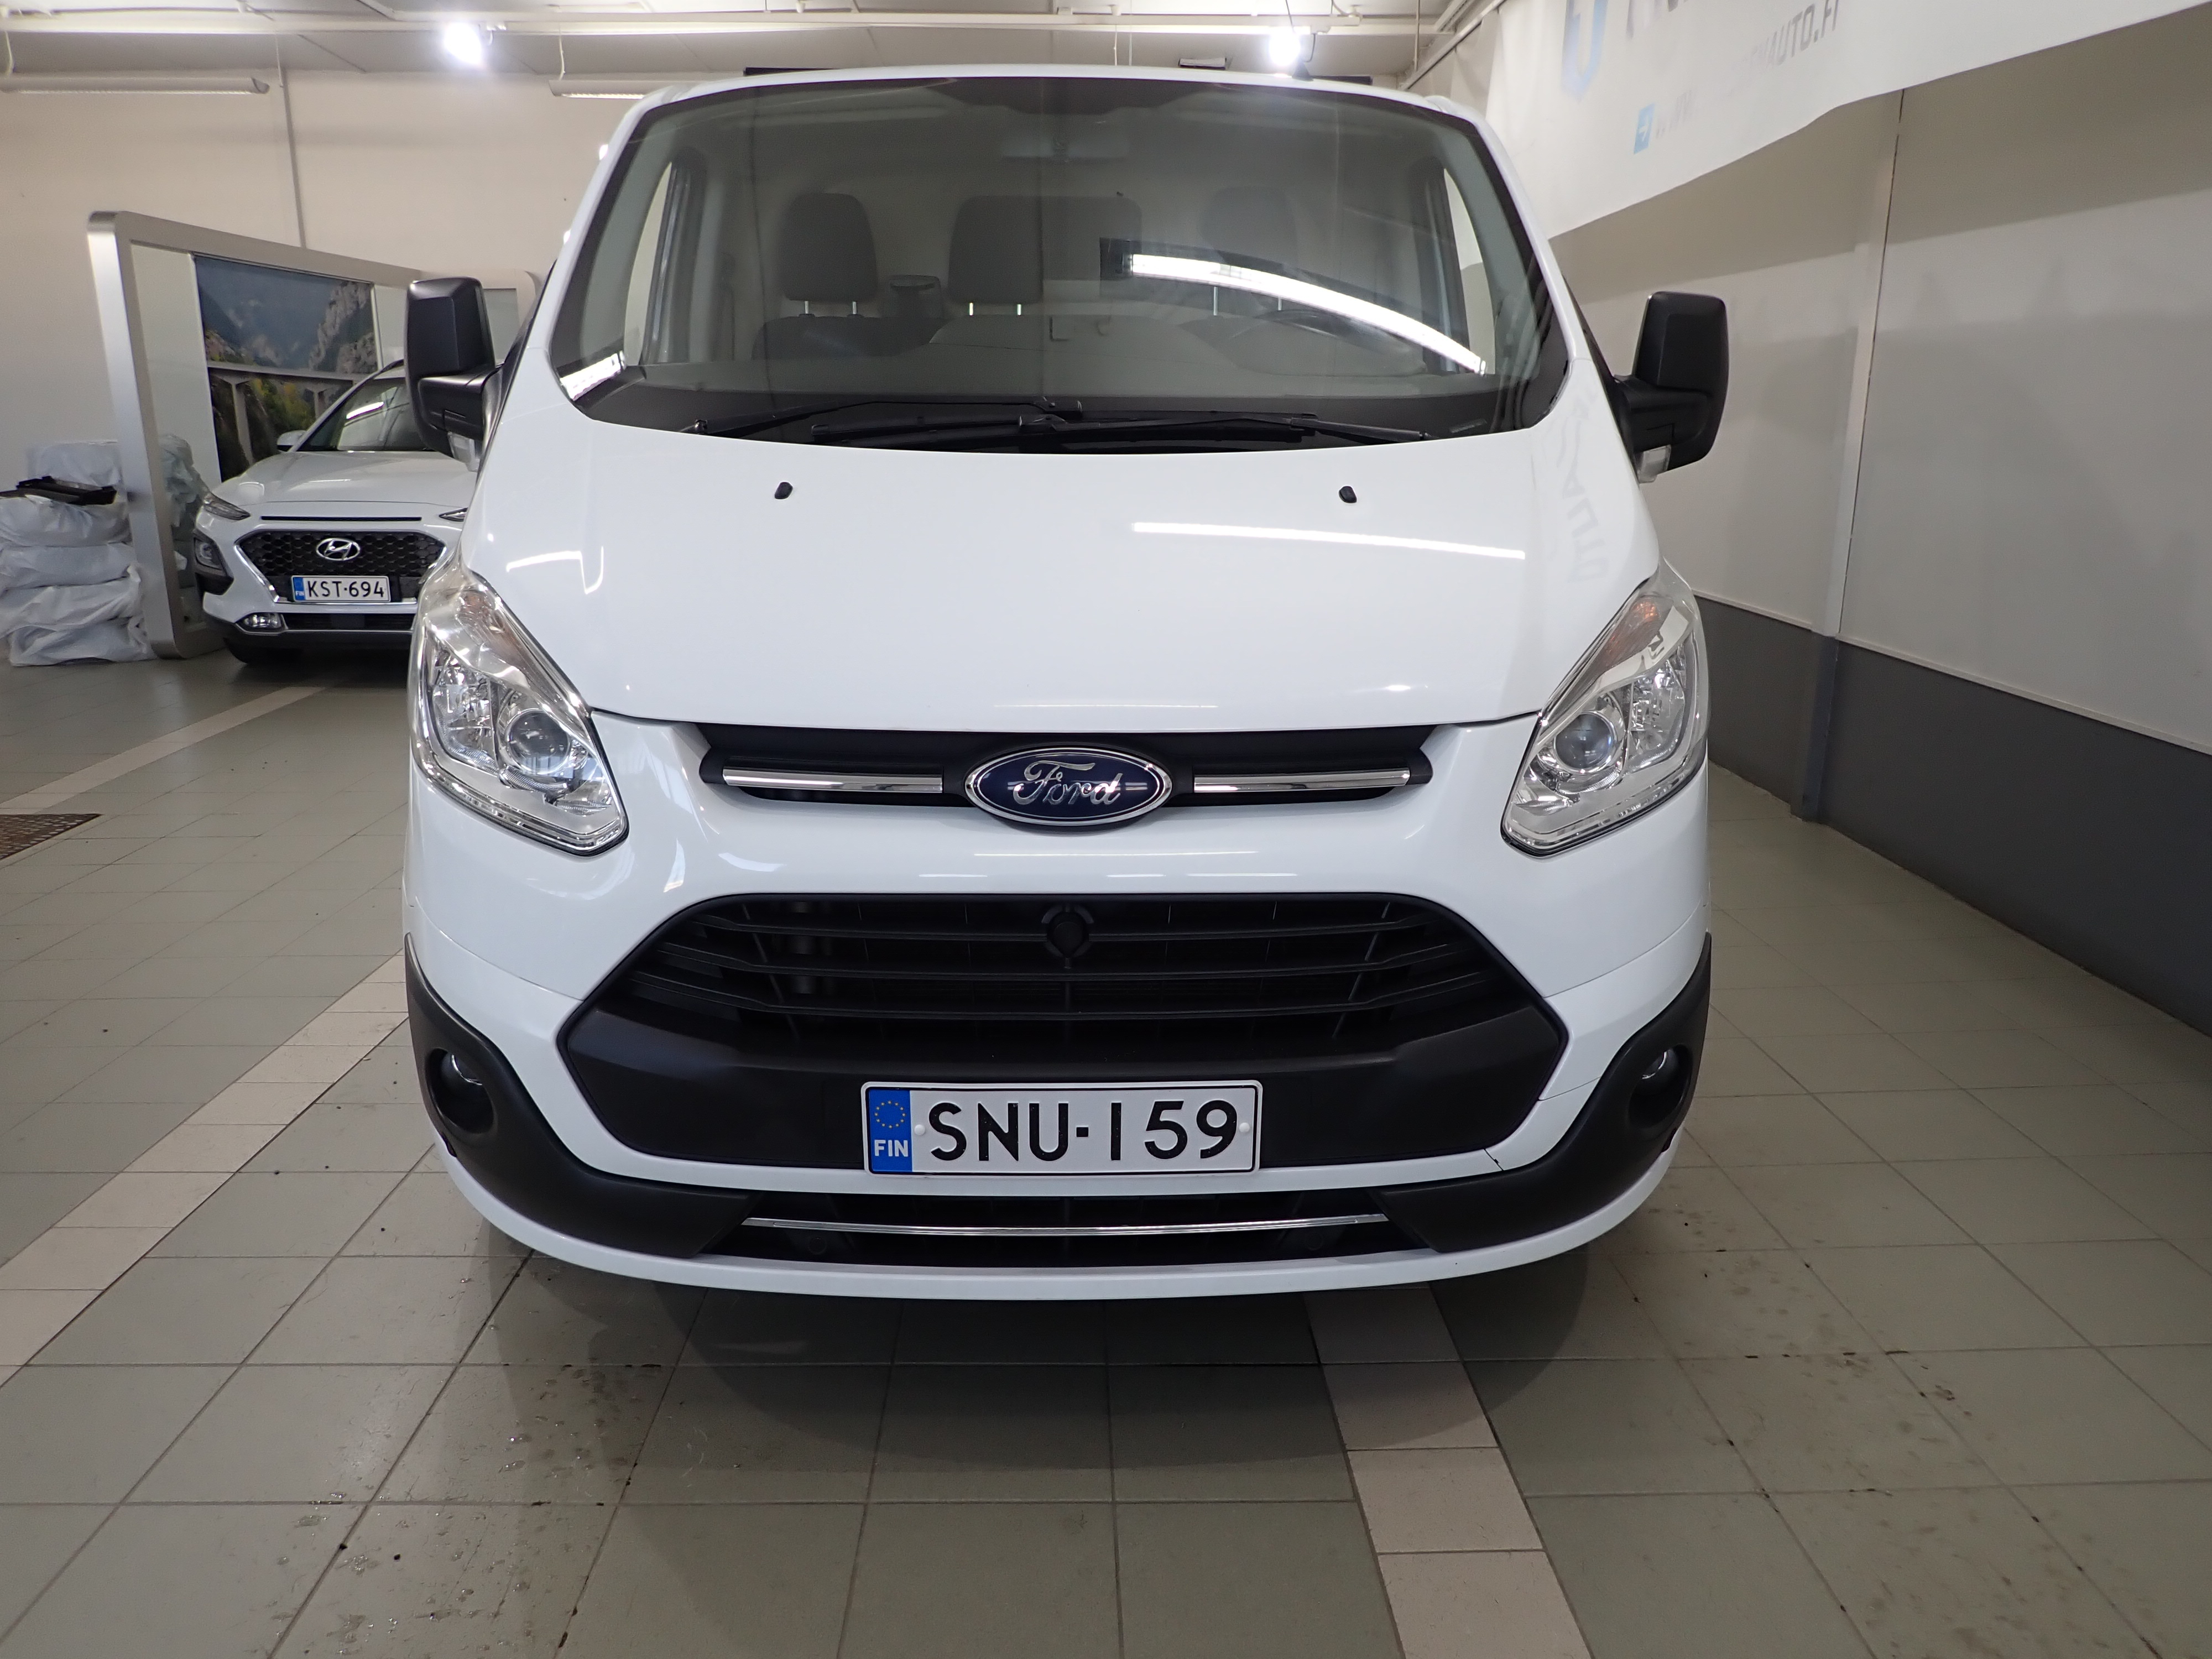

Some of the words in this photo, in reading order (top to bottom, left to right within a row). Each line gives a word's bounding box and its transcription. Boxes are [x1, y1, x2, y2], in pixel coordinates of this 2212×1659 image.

[306, 581, 384, 598] KST-694
[1013, 760, 1123, 806] Ford
[874, 1139, 909, 1157] FIN
[928, 1099, 1239, 1162] SNU-159
